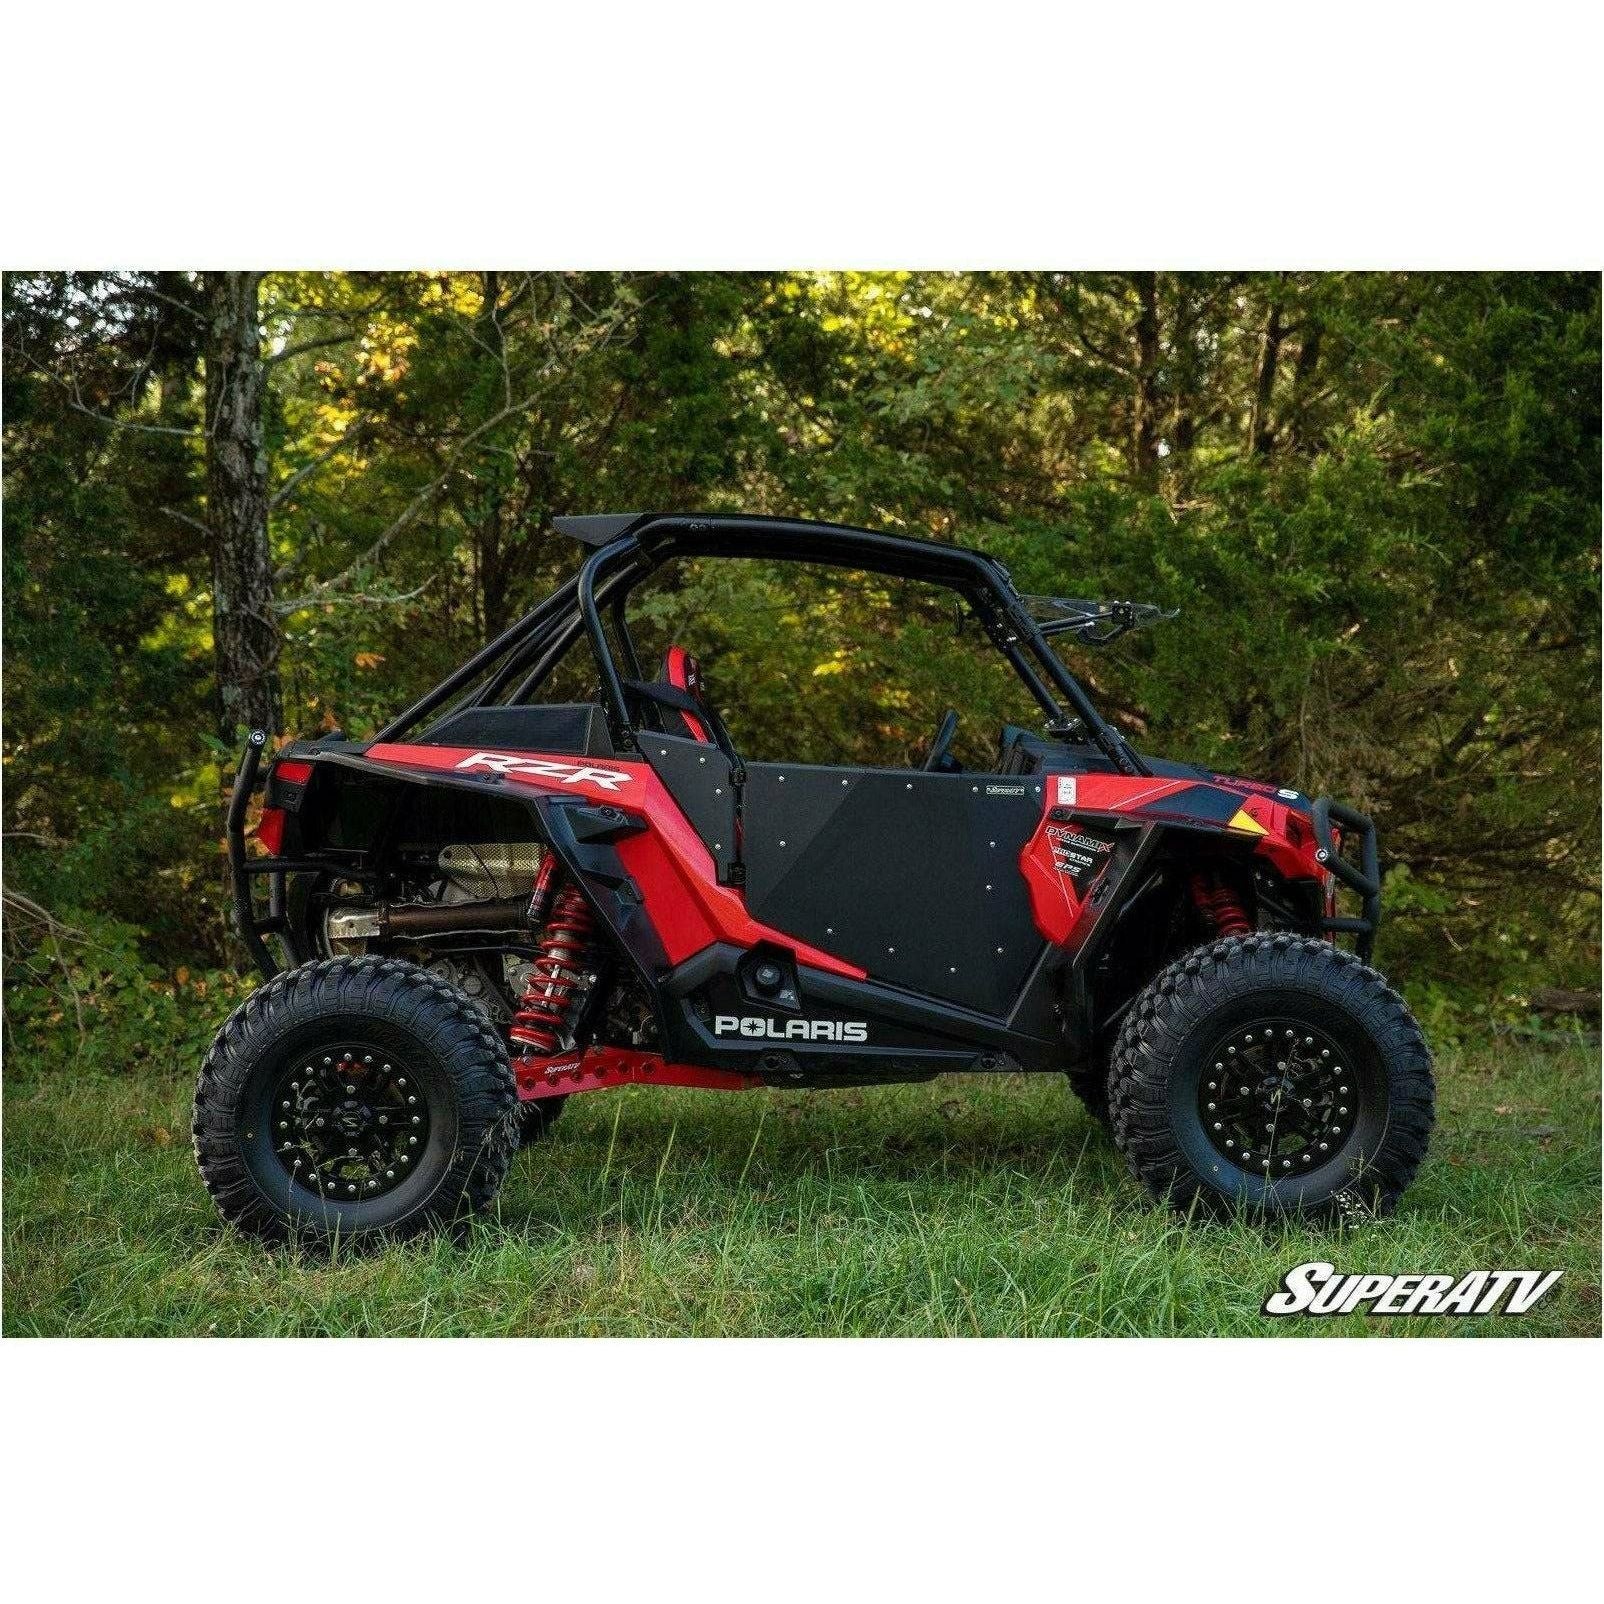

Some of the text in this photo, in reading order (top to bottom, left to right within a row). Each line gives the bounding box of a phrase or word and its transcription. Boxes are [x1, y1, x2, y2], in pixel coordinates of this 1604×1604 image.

[454, 751, 634, 792] RZR
[1045, 825, 1115, 852] DYNAMIX
[715, 1015, 868, 1042] POLARIS
